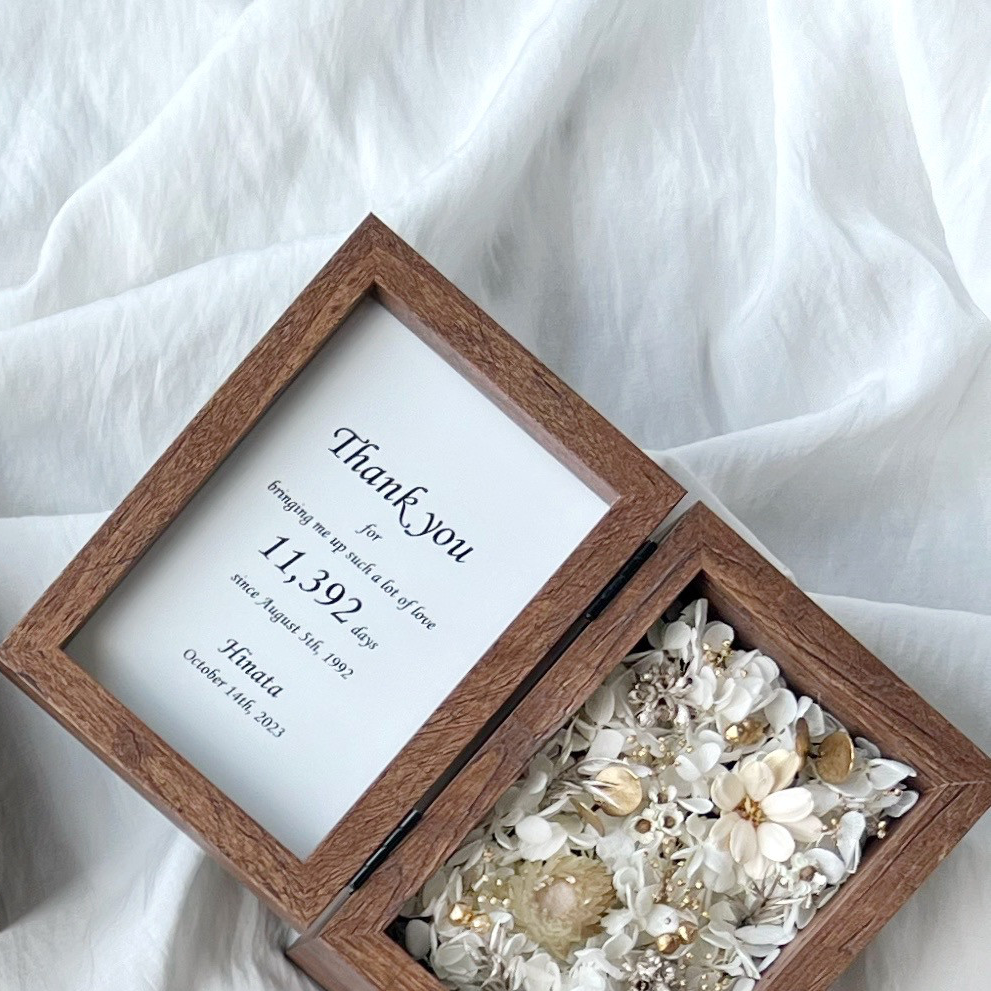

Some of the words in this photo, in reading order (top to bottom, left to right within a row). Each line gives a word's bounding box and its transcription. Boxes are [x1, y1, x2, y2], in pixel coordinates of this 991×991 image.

[327, 427, 428, 528] Thank
[403, 511, 473, 563] you
[354, 523, 382, 541] for
[257, 535, 362, 624] 11,392
[350, 626, 378, 649] days
[267, 480, 314, 525] bringing
[311, 521, 331, 538] me
[329, 537, 347, 553] up
[344, 551, 376, 575] such
[370, 574, 382, 583] a
[379, 579, 399, 597] lot
[396, 596, 418, 610] of
[410, 605, 436, 630] love
[217, 638, 283, 698] Hinata
[230, 573, 259, 598] since
[254, 596, 300, 634] August
[297, 631, 324, 655] 5th,
[321, 652, 353, 679] 1992
[182, 648, 227, 687] October
[225, 686, 256, 714] 14th,
[253, 711, 285, 737] 2023
